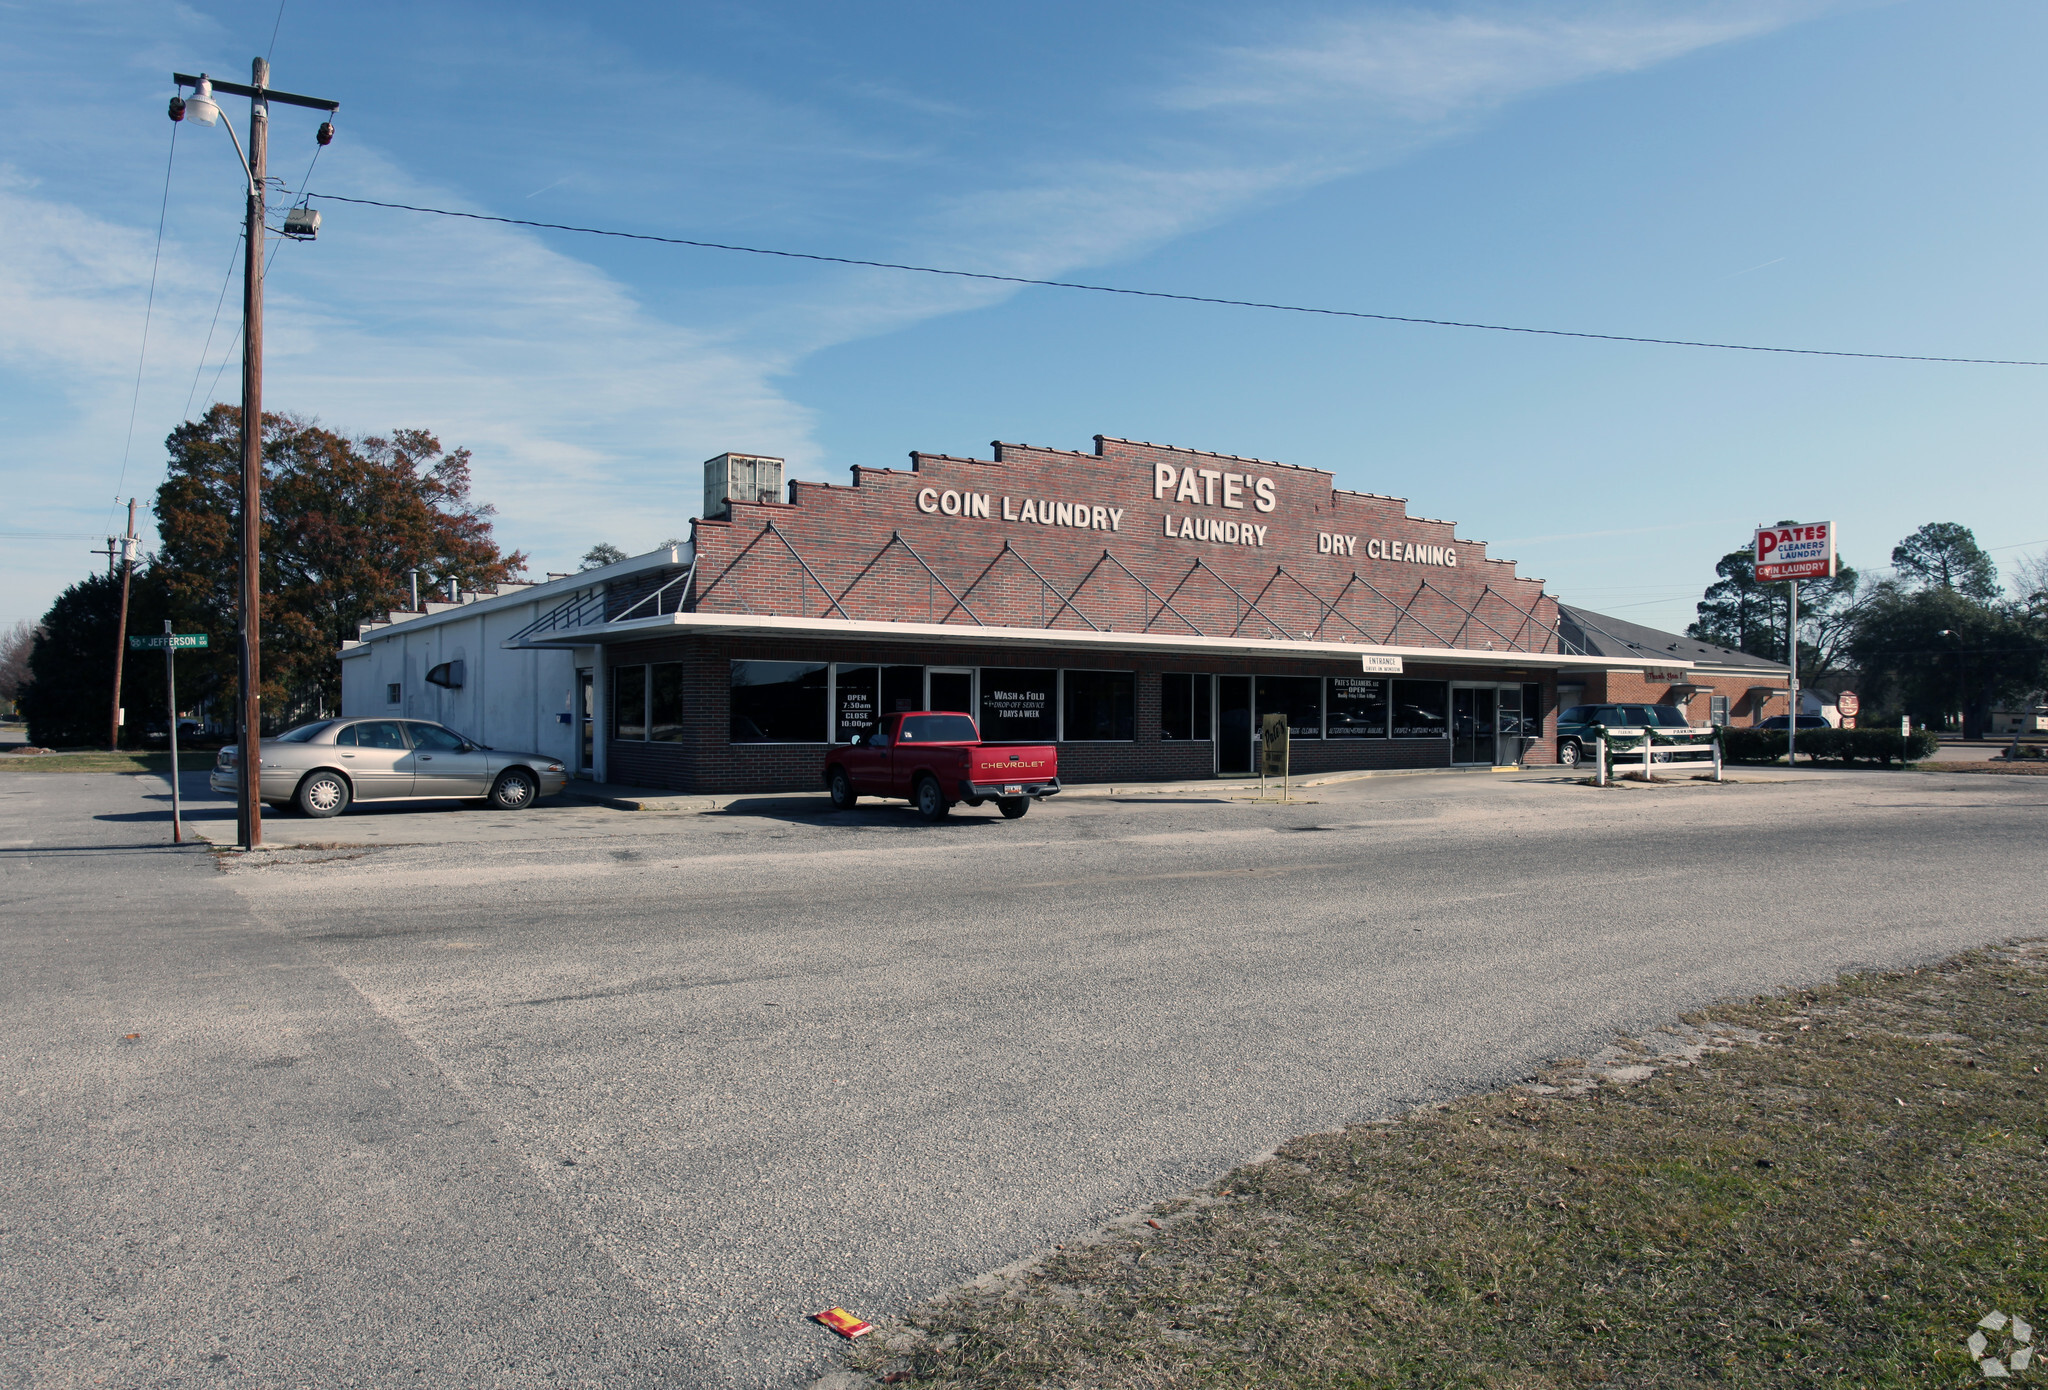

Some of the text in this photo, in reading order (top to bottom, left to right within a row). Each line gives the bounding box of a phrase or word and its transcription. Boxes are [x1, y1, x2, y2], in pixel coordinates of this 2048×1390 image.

[1153, 462, 1276, 513] PATE'S
[917, 487, 1124, 532] COIN LAUNDRY
[1164, 514, 1268, 547] LAUNDRY
[1758, 525, 1827, 562] PATES
[1778, 541, 1824, 552] CLEANERS
[1318, 533, 1457, 568] DRY CLEANING
[1780, 550, 1822, 559] LAUNDRY
[1782, 562, 1824, 573] LAUNDRY
[148, 637, 196, 647] JEFFERSON
[1369, 657, 1396, 665] ENTRANCE
[1648, 672, 1665, 680] Thank
[994, 690, 1018, 700] WASH
[1026, 691, 1045, 700] FOLD
[999, 710, 1040, 718] 7 DAYS A WEEK
[841, 720, 873, 728] 10:00pm
[980, 760, 1046, 769] CHEVROLET
